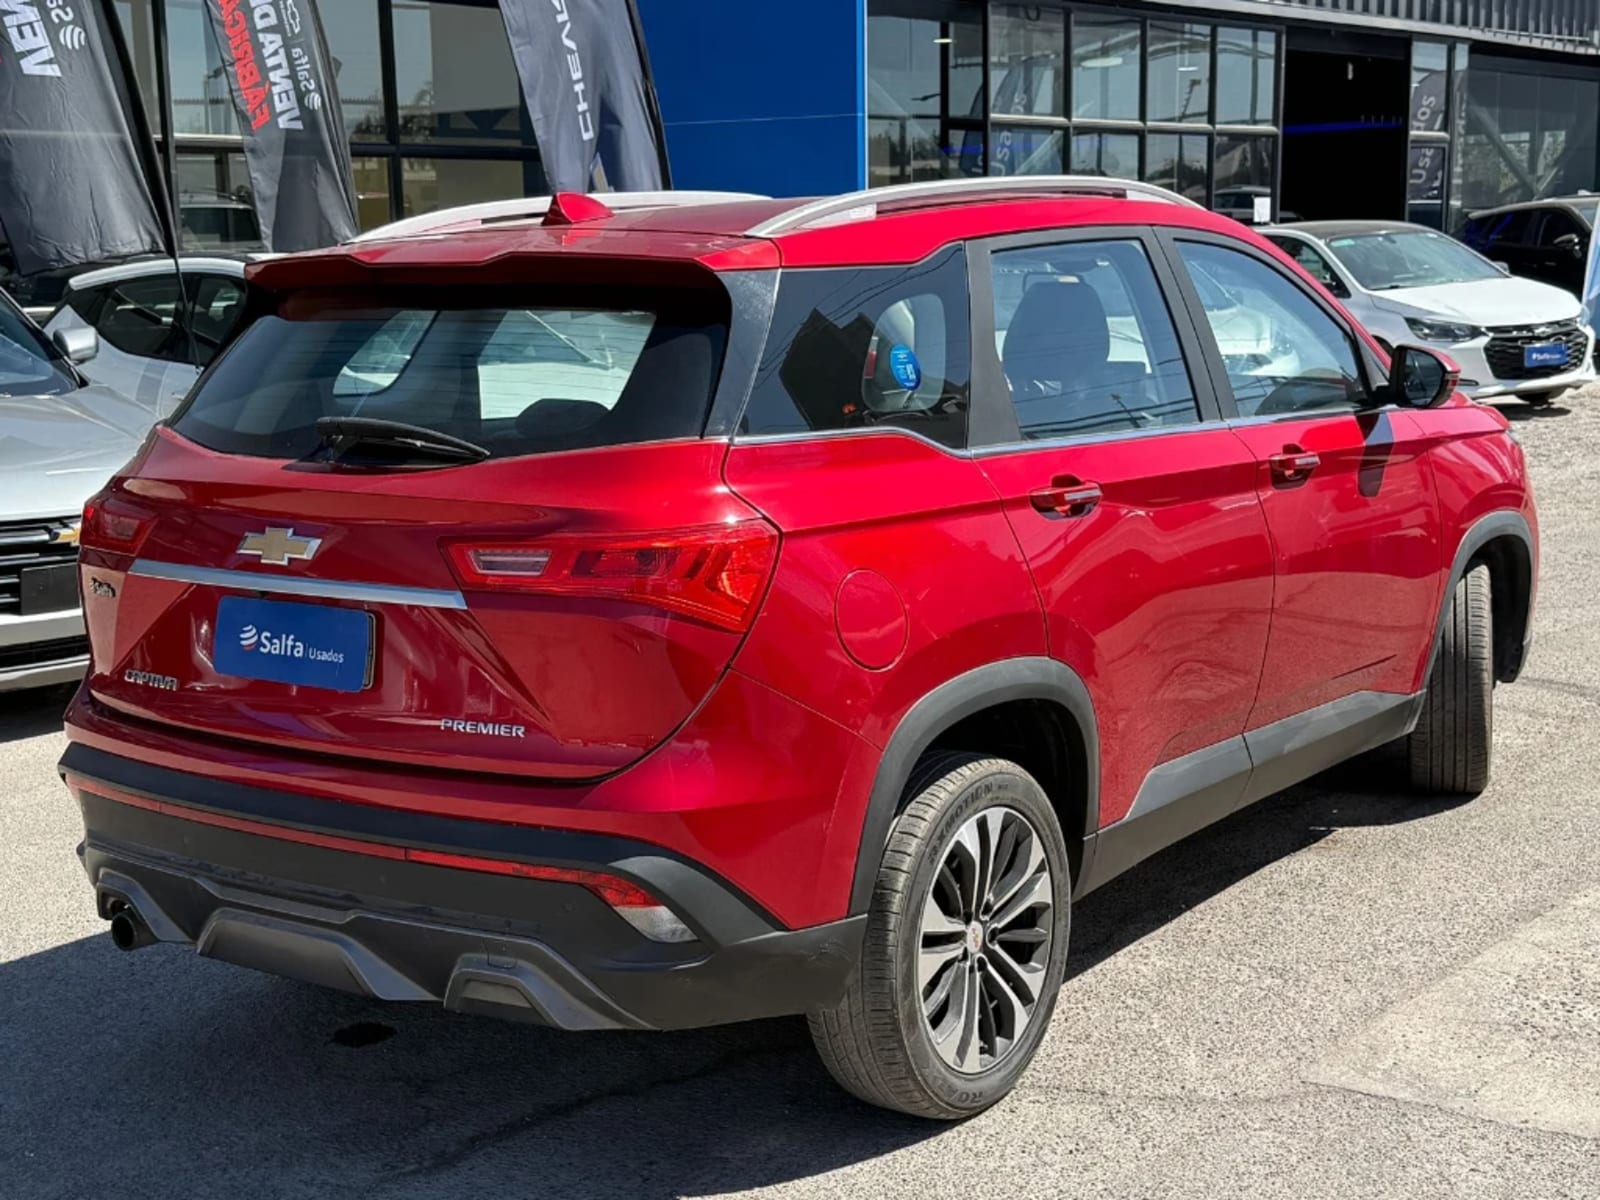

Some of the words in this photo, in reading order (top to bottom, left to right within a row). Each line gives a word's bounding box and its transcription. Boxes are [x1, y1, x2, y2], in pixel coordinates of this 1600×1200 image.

[259, 631, 304, 658] Salfa
[309, 648, 344, 663] Usados
[124, 669, 177, 691] CAPTIVA
[440, 718, 525, 738] PREMIER
